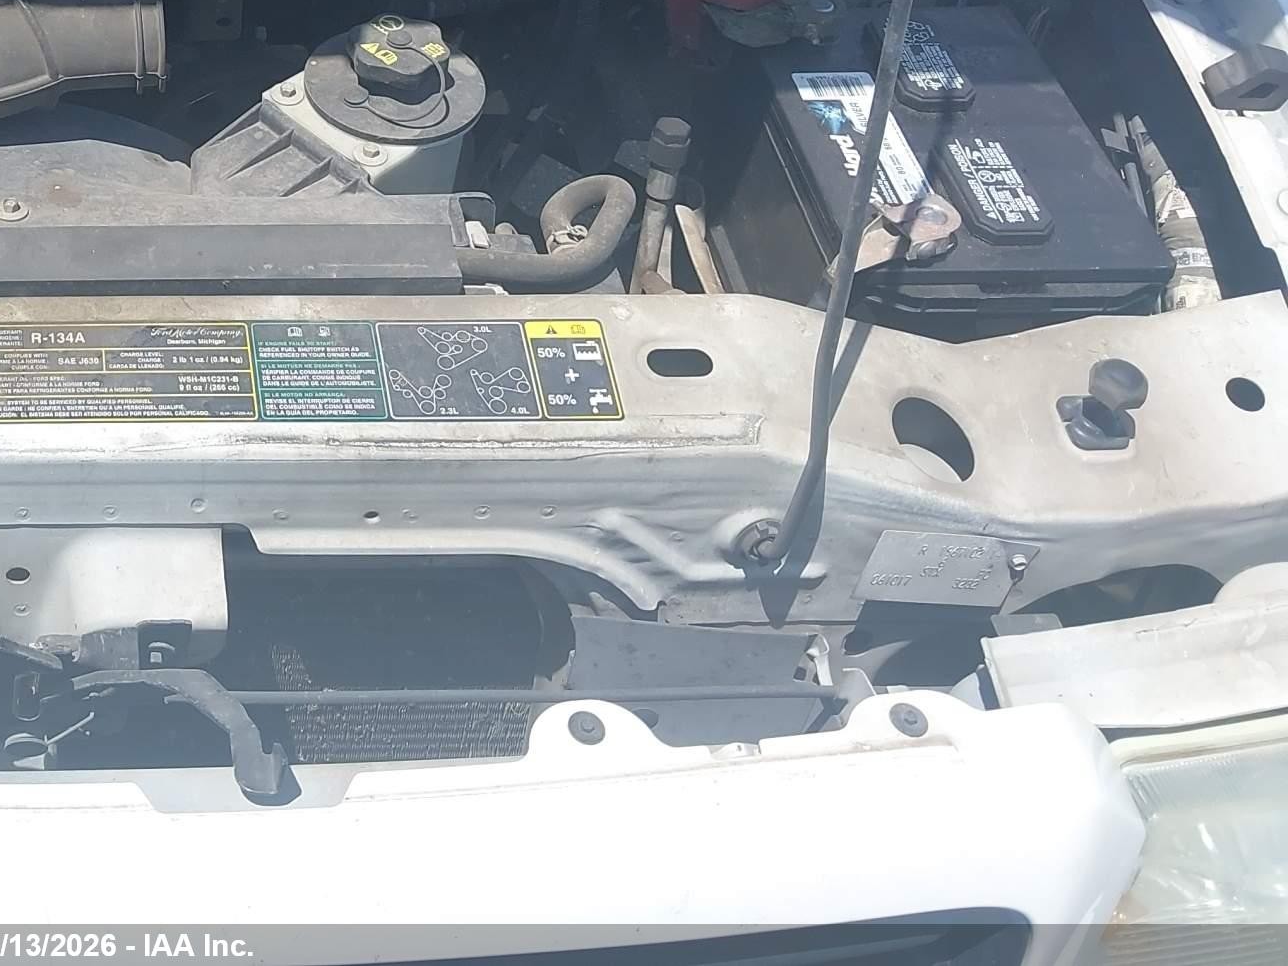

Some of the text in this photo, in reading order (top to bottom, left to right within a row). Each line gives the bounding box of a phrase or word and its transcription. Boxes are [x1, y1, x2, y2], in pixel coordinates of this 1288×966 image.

[947, 144, 972, 174] POISON
[967, 179, 993, 212] DANGER
[31, 332, 85, 344] R-134A
[537, 347, 566, 358] 50%
[58, 357, 76, 365] SAE
[548, 394, 577, 405] 50%
[440, 407, 459, 416] 2.3L
